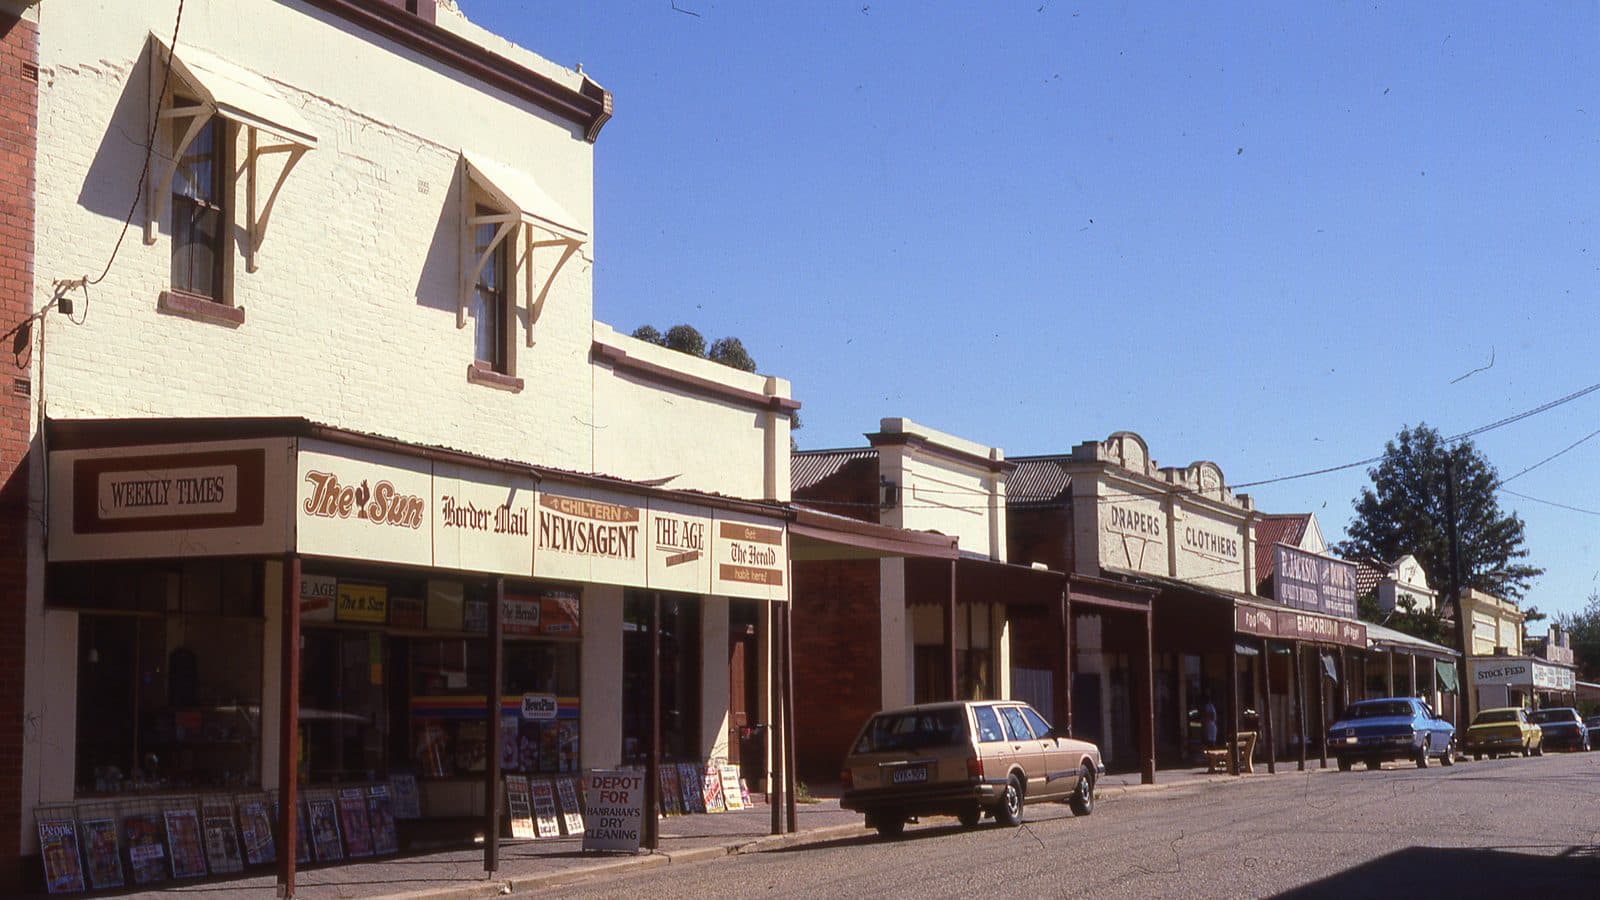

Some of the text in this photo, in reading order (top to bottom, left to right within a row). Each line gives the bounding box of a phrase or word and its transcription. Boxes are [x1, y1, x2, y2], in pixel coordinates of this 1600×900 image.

[111, 476, 225, 508] WEEKLY TIMES
[305, 470, 425, 530] The Sun
[441, 495, 529, 537] Border Mail
[560, 499, 620, 520] CHILTERN
[1111, 504, 1160, 537] DRAPERS
[538, 510, 639, 559] NEWSAGENT
[655, 516, 705, 551] THE AGE
[1185, 525, 1237, 558] CLOTHIERS
[731, 541, 776, 566] The Herald
[311, 582, 337, 597] AGE
[1296, 615, 1339, 638] EMPORIUM
[1478, 668, 1503, 680] STOCK
[1504, 665, 1526, 677] FEED
[592, 776, 641, 790] DEPOT
[600, 790, 629, 804] FOR
[586, 807, 641, 817] HANRAHAN'S
[600, 817, 625, 828] DRY
[585, 828, 637, 841] CLEANING
